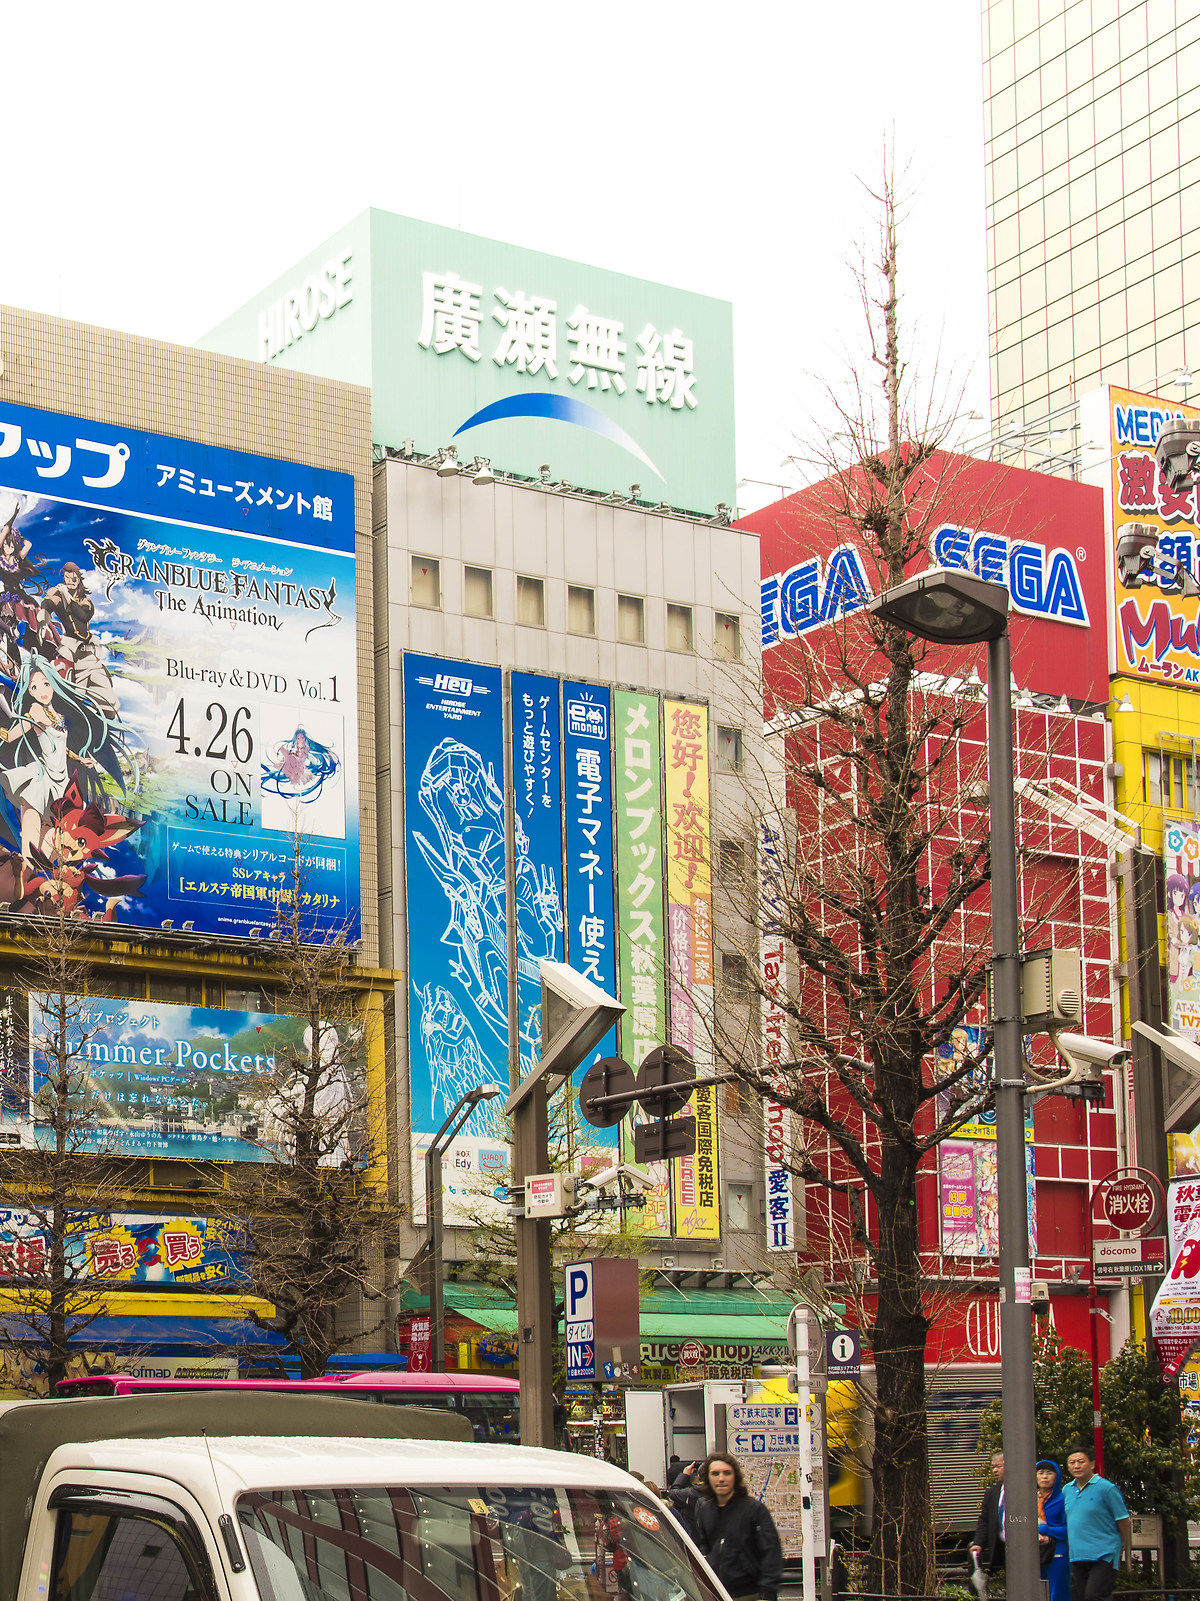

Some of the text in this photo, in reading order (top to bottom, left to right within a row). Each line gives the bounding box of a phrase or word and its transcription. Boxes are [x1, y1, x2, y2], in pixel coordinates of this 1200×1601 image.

[259, 249, 355, 364] HIROSE
[417, 271, 699, 411] 廣瀬無線
[155, 463, 333, 522] アミューズメント館
[137, 539, 293, 576] グランブルーファンタジー ジ・アニメーション
[99, 550, 339, 614] GRANBLUE FANTASY
[930, 525, 1091, 627] SEGA
[155, 590, 284, 630] The Animation
[760, 543, 874, 650] EGA
[1120, 600, 1200, 664] Mu
[1139, 657, 1183, 679] ムーラン
[297, 675, 341, 703] Vol.1
[433, 674, 473, 697] Hey
[425, 703, 481, 717] ENTERTAINMENT
[441, 698, 466, 709] HIROSE
[443, 712, 463, 721] YARD
[166, 697, 254, 764] 4.26
[571, 722, 604, 736] money
[539, 695, 551, 809] ゲームセンターを
[210, 769, 253, 797] ON
[186, 795, 254, 826] SALE
[232, 867, 287, 883] SSレアキャラ
[624, 703, 657, 1067] メロンブックス秋葉原店
[51, 1007, 160, 1029] Ky新プロジェクト
[175, 1040, 277, 1075] Pockets
[455, 1158, 472, 1170] Edy
[481, 1153, 505, 1162] WAON
[681, 1155, 696, 1207] FREE
[1124, 1183, 1145, 1191] HYDRANT
[1109, 1192, 1150, 1215] 消火栓
[91, 1238, 137, 1276] 売る
[163, 1230, 201, 1266] 買う
[569, 1270, 589, 1316] P
[411, 1321, 430, 1332] 秋葉原
[567, 1324, 593, 1341] ダイビル
[966, 1301, 1002, 1356] CLU
[567, 1345, 582, 1368] IN
[124, 1365, 171, 1379] Sofmap
[641, 1366, 671, 1381] 気製品
[1179, 1371, 1199, 1391] 市場
[733, 1407, 782, 1419] 地下鉄末広町駅
